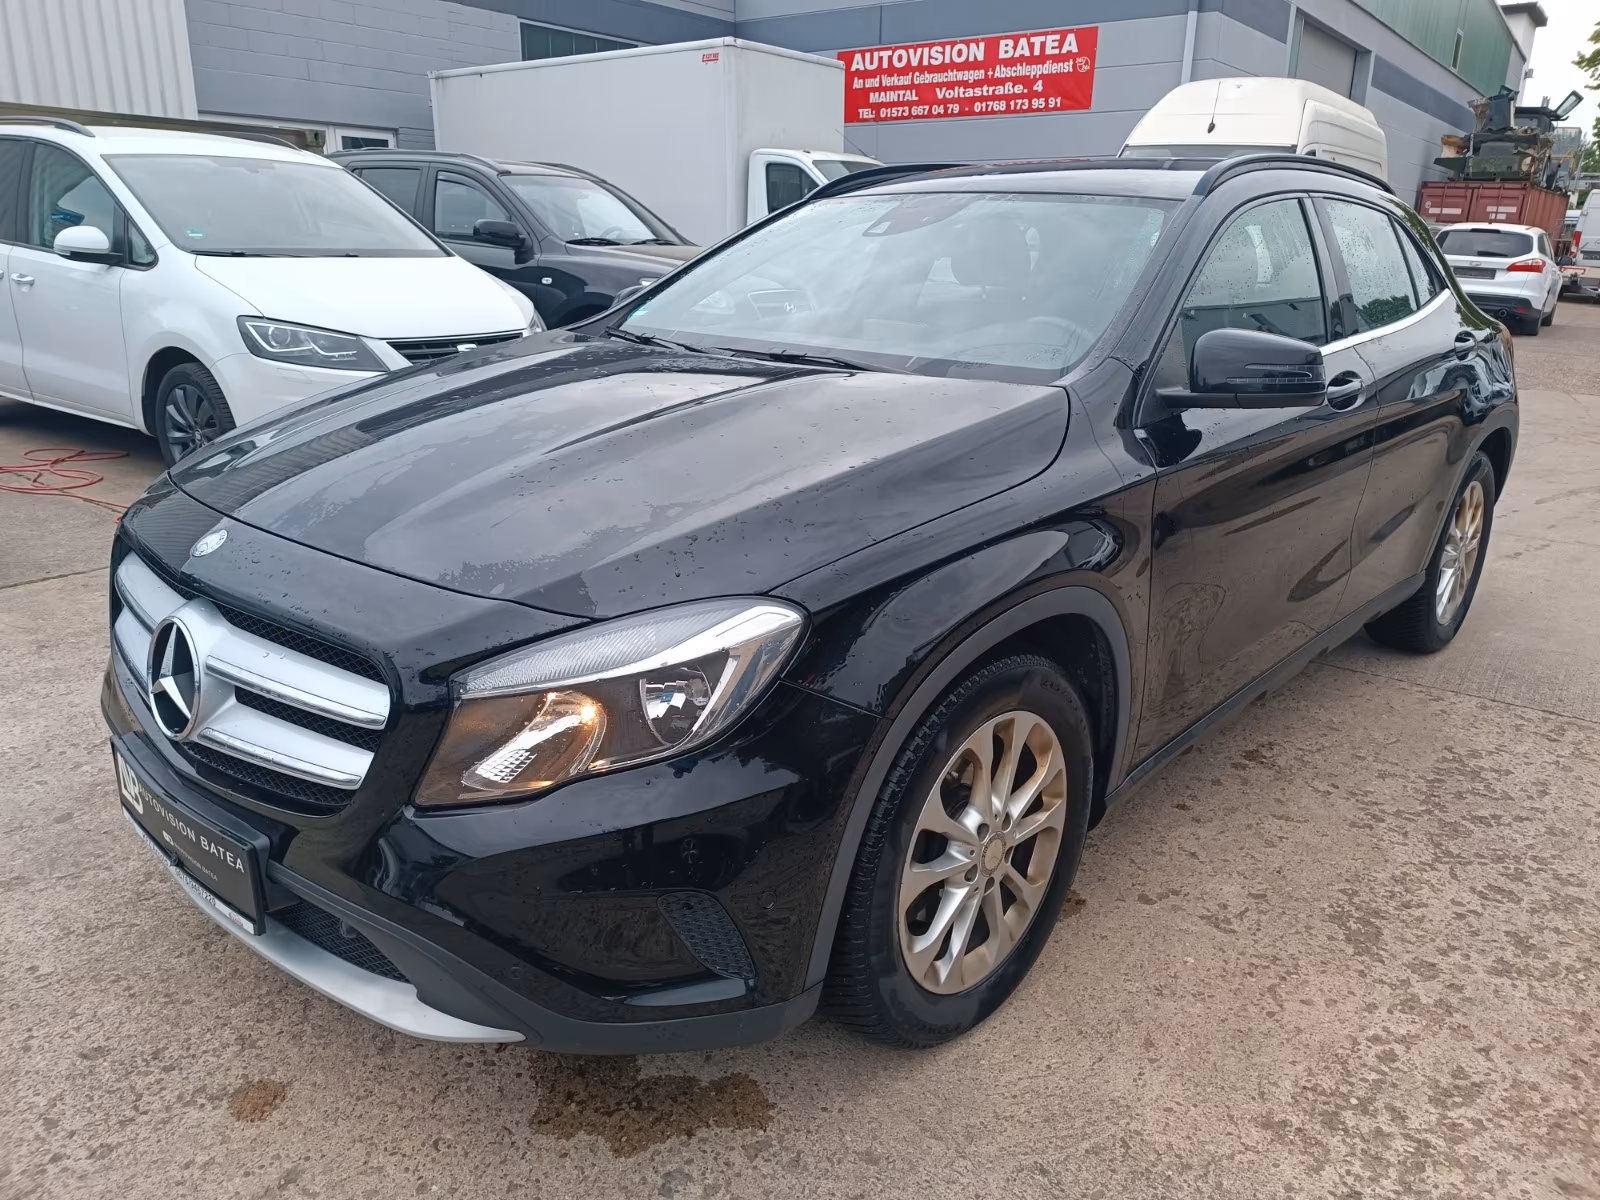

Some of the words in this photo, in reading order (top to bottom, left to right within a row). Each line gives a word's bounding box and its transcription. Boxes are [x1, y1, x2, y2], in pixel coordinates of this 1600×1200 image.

[850, 42, 985, 71] AUTOVISION
[998, 33, 1079, 59] BATEA
[852, 76, 864, 89] An
[865, 75, 880, 87] und
[881, 72, 913, 87] Verkauf
[913, 69, 985, 84] Gebrauchtwagen
[869, 89, 919, 103] MAINTAL
[935, 82, 1028, 99] Voltastraße.
[1032, 79, 1043, 92] 4
[858, 108, 876, 119] TEL:
[880, 106, 909, 118] 01573
[911, 105, 930, 116] 667
[932, 104, 944, 115] 04
[947, 103, 960, 114] 79
[974, 100, 1006, 112] 01768
[1009, 98, 1029, 110] 173
[1031, 97, 1045, 109] 95
[1048, 96, 1062, 108] 91
[138, 783, 196, 842] AUTOVISION
[200, 835, 245, 874] BATEA
